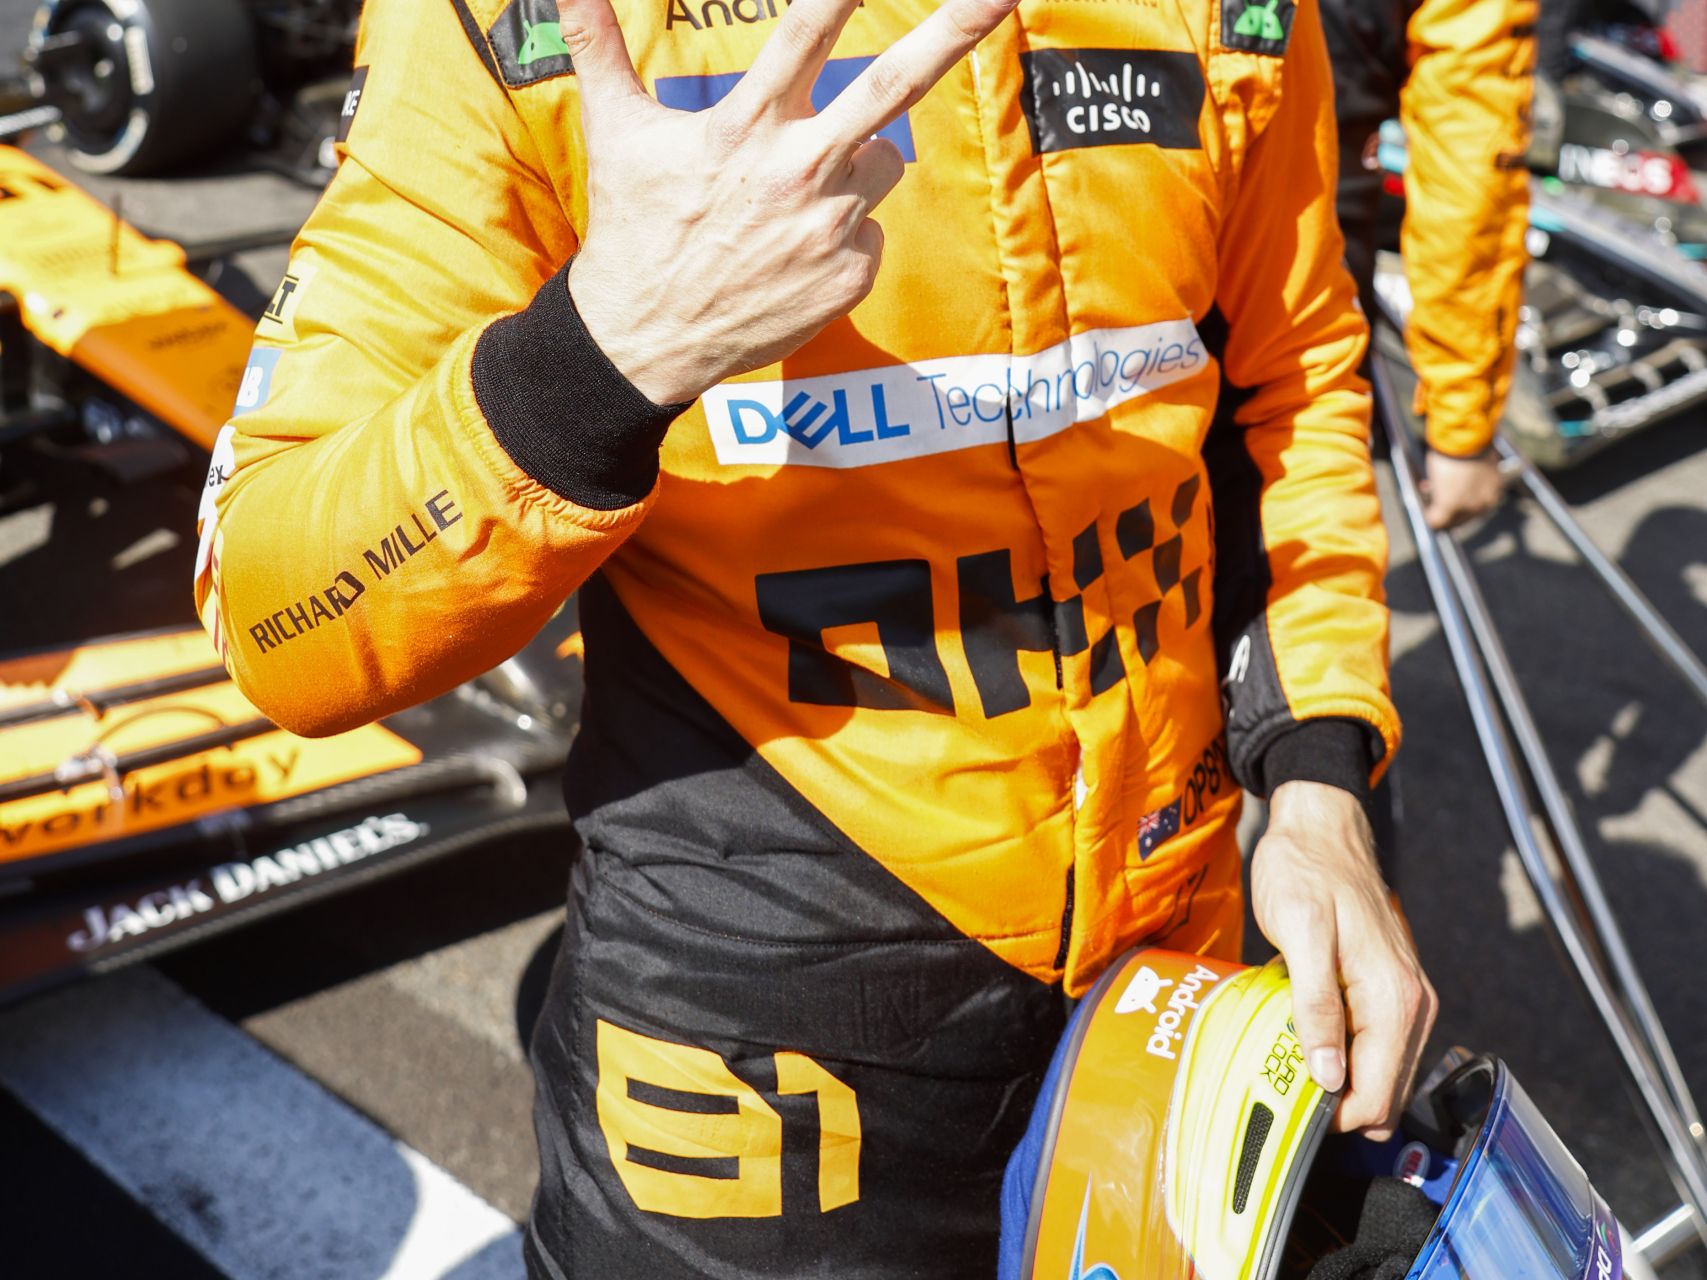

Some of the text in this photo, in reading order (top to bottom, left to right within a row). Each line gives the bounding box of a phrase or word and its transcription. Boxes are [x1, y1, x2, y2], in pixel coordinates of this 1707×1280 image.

[1559, 143, 1673, 196] INEOS
[726, 336, 1202, 451] DELL Technologies
[249, 570, 366, 655] RICHARD
[362, 489, 464, 581] MILLE
[67, 812, 422, 952] JACK DANIEL'S
[1146, 964, 1220, 1061] Android
[1259, 1032, 1293, 1084] LOCK
[596, 1018, 861, 1220] 81
